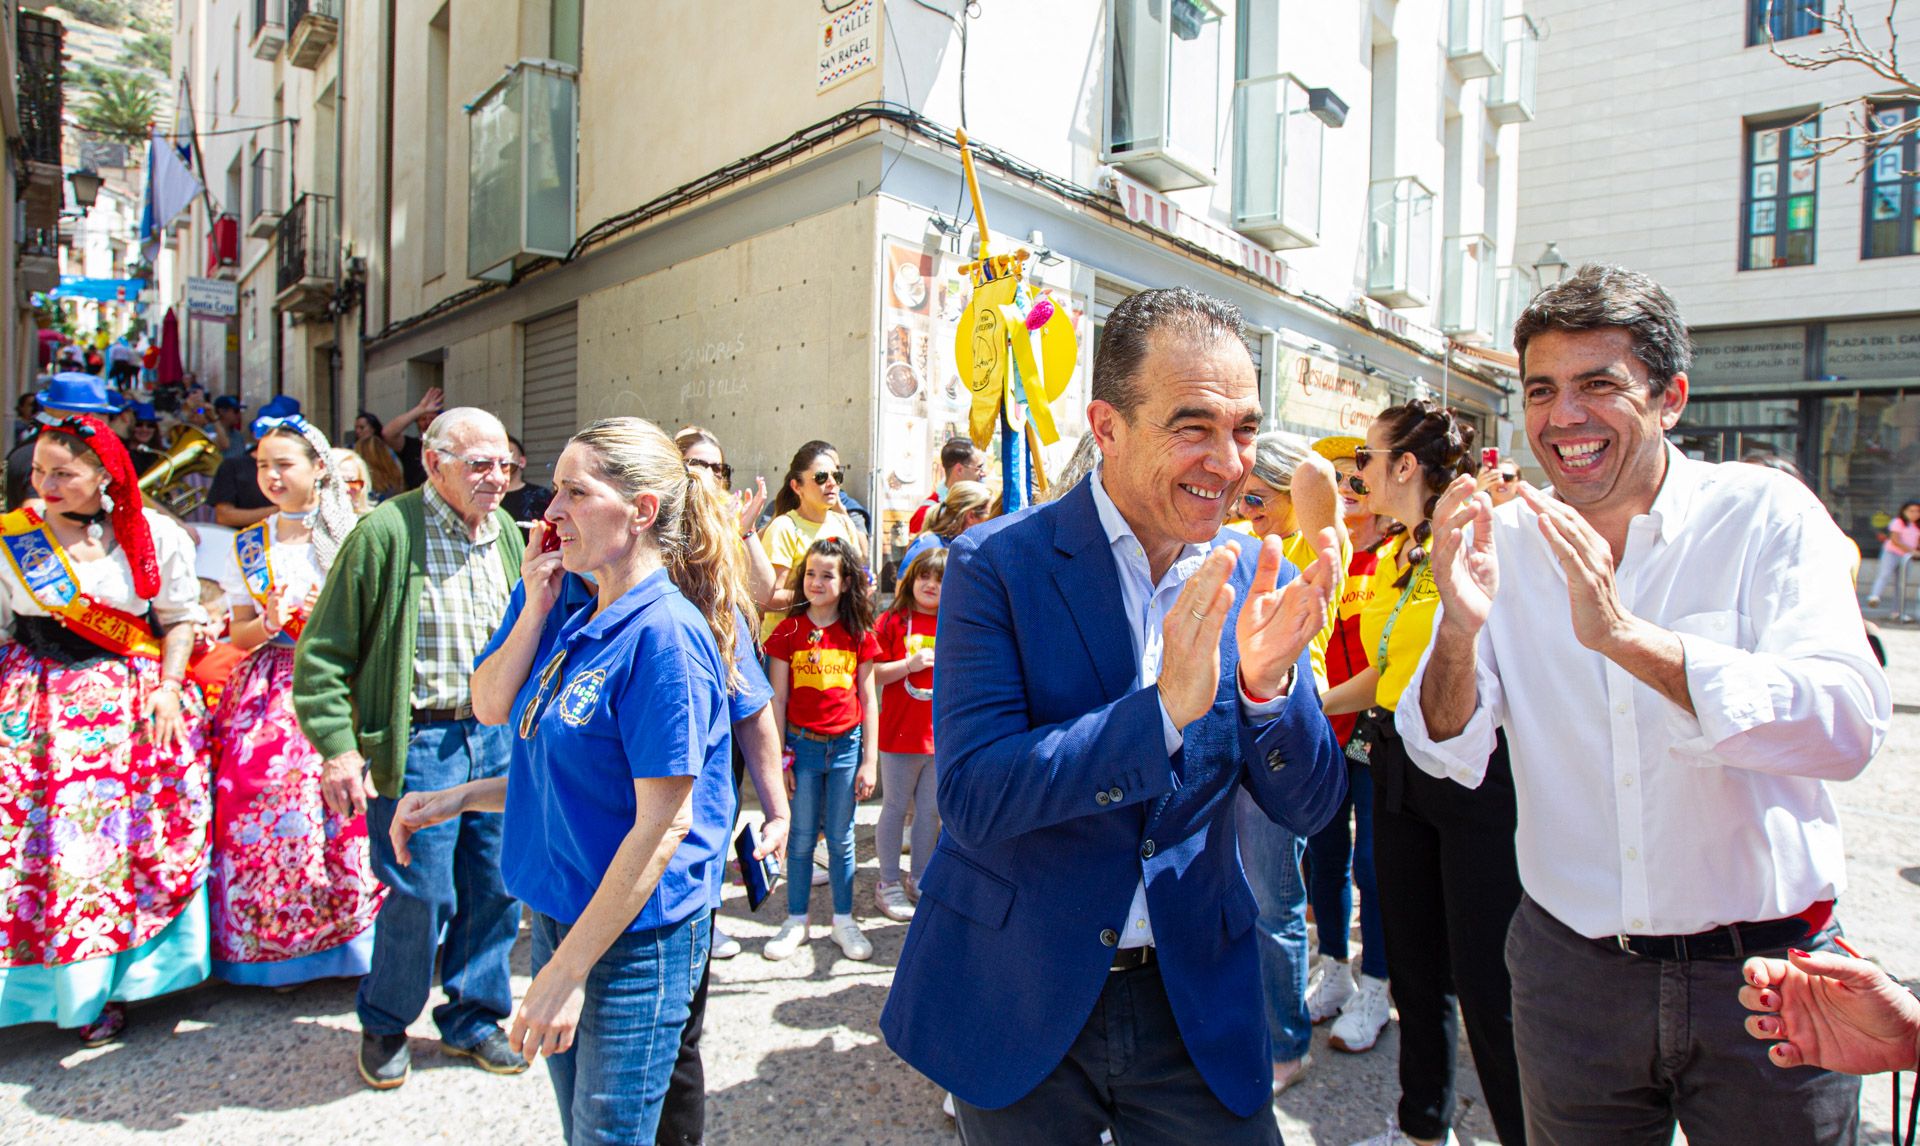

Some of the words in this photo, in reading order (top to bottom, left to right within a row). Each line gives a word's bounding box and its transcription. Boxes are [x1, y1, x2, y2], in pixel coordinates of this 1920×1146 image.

[839, 9, 871, 37] CALLE
[820, 54, 836, 70] SAN
[838, 36, 871, 63] RAFAEL
[1723, 341, 1804, 354] COMUNITARIO
[1828, 337, 1867, 347] PLAZA
[1871, 336, 1893, 345] DEL
